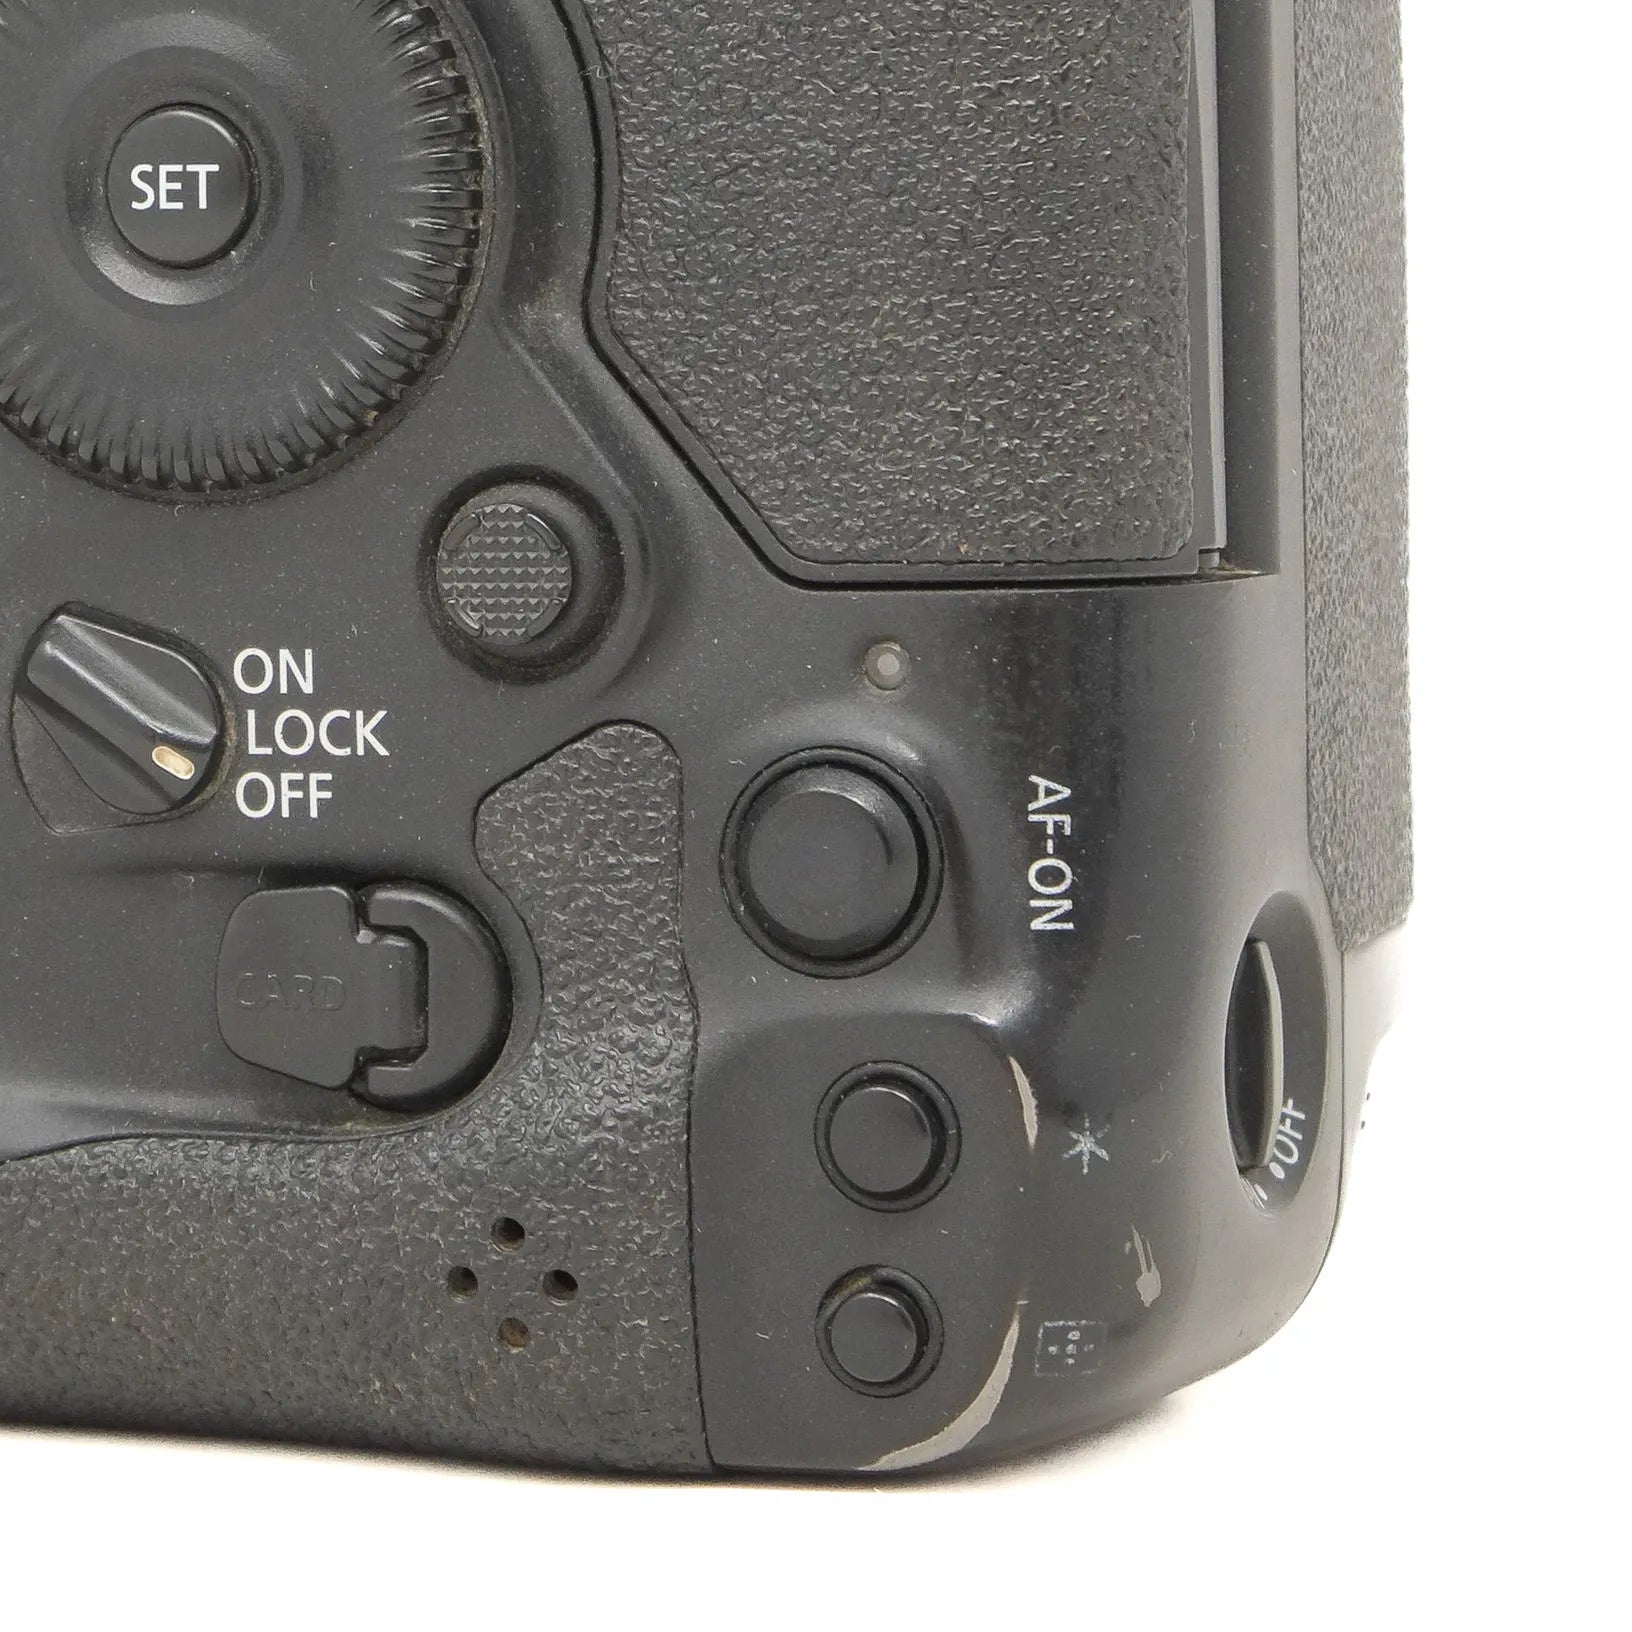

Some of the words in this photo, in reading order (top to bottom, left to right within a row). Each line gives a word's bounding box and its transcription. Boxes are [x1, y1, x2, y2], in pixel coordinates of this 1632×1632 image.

[130, 164, 220, 210] SET
[233, 648, 314, 695] ON
[247, 709, 390, 756] LOCK
[235, 771, 333, 819] OFF
[1027, 774, 1074, 931] AF-ON
[236, 972, 346, 1011] CARD
